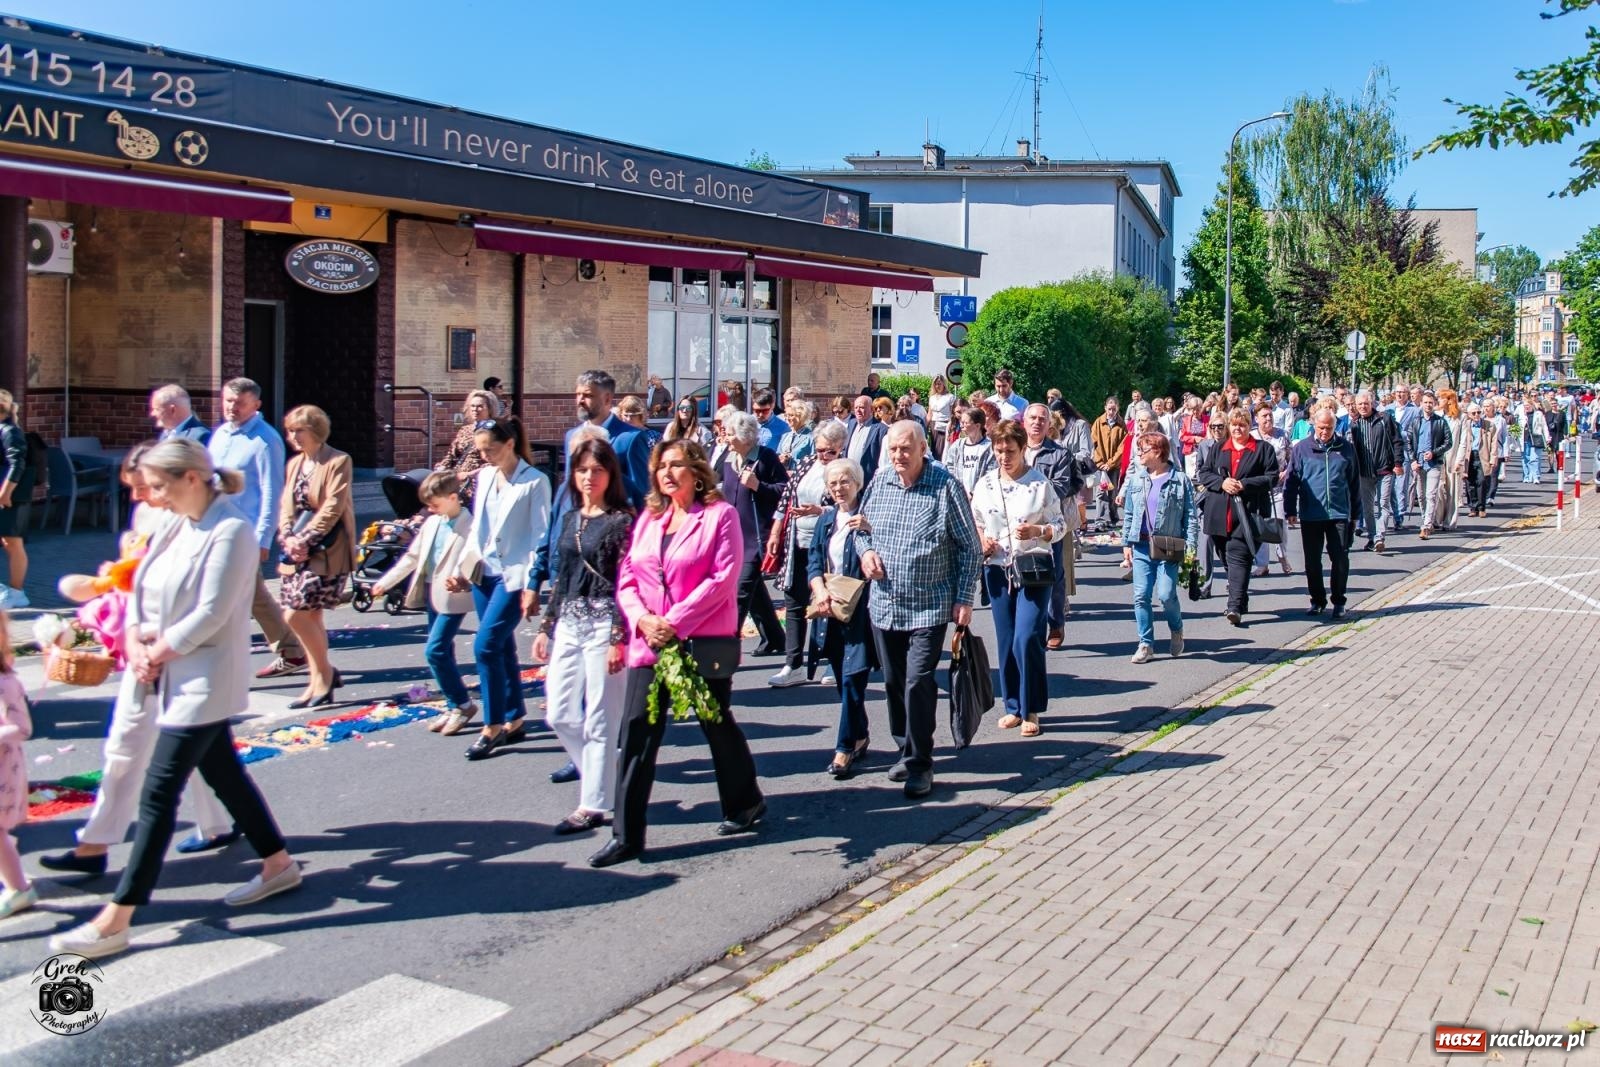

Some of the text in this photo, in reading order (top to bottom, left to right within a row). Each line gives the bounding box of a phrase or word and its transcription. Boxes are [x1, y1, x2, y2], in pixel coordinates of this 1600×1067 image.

[0, 43, 197, 108] 415 14 28
[0, 103, 85, 142] ANT
[327, 101, 754, 204] You'll never drink & eat alone
[60, 242, 70, 250] LG
[293, 243, 374, 267] STACJA MIEJSKA
[313, 260, 354, 273] OKOCIM
[902, 337, 916, 355] P
